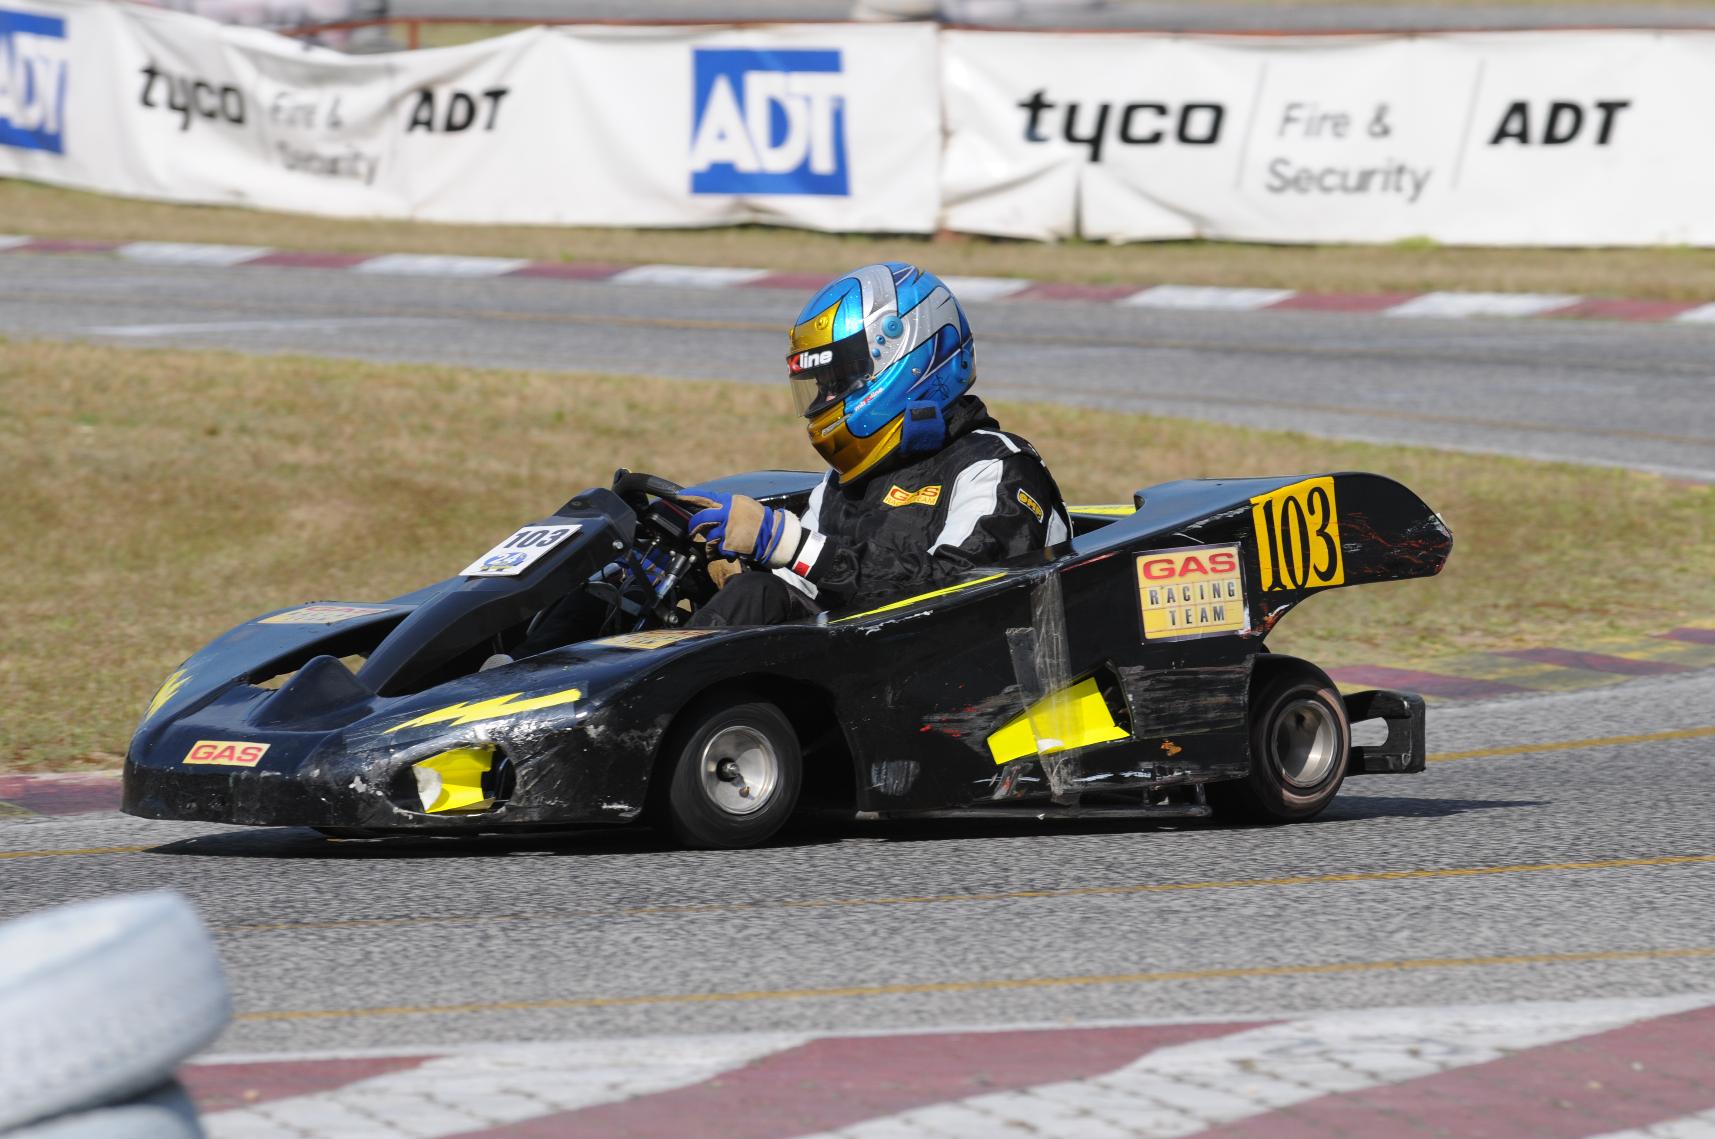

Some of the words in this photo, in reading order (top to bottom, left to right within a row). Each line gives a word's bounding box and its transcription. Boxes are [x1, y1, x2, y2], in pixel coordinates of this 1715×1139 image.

[139, 64, 246, 131] tyco
[405, 88, 510, 133] ADT
[688, 70, 846, 174] ADT
[1016, 89, 1226, 163] tyco
[1277, 102, 1350, 138] Fire
[1366, 104, 1392, 138] &
[1488, 100, 1631, 146] ADT
[1265, 157, 1431, 202] Security
[890, 486, 939, 501] GS
[503, 528, 570, 548] 103
[1262, 486, 1338, 591] 103
[1143, 552, 1237, 581] GAS
[1149, 582, 1235, 605] RACING
[1168, 605, 1225, 626] TEAM
[190, 744, 263, 763] GAS
